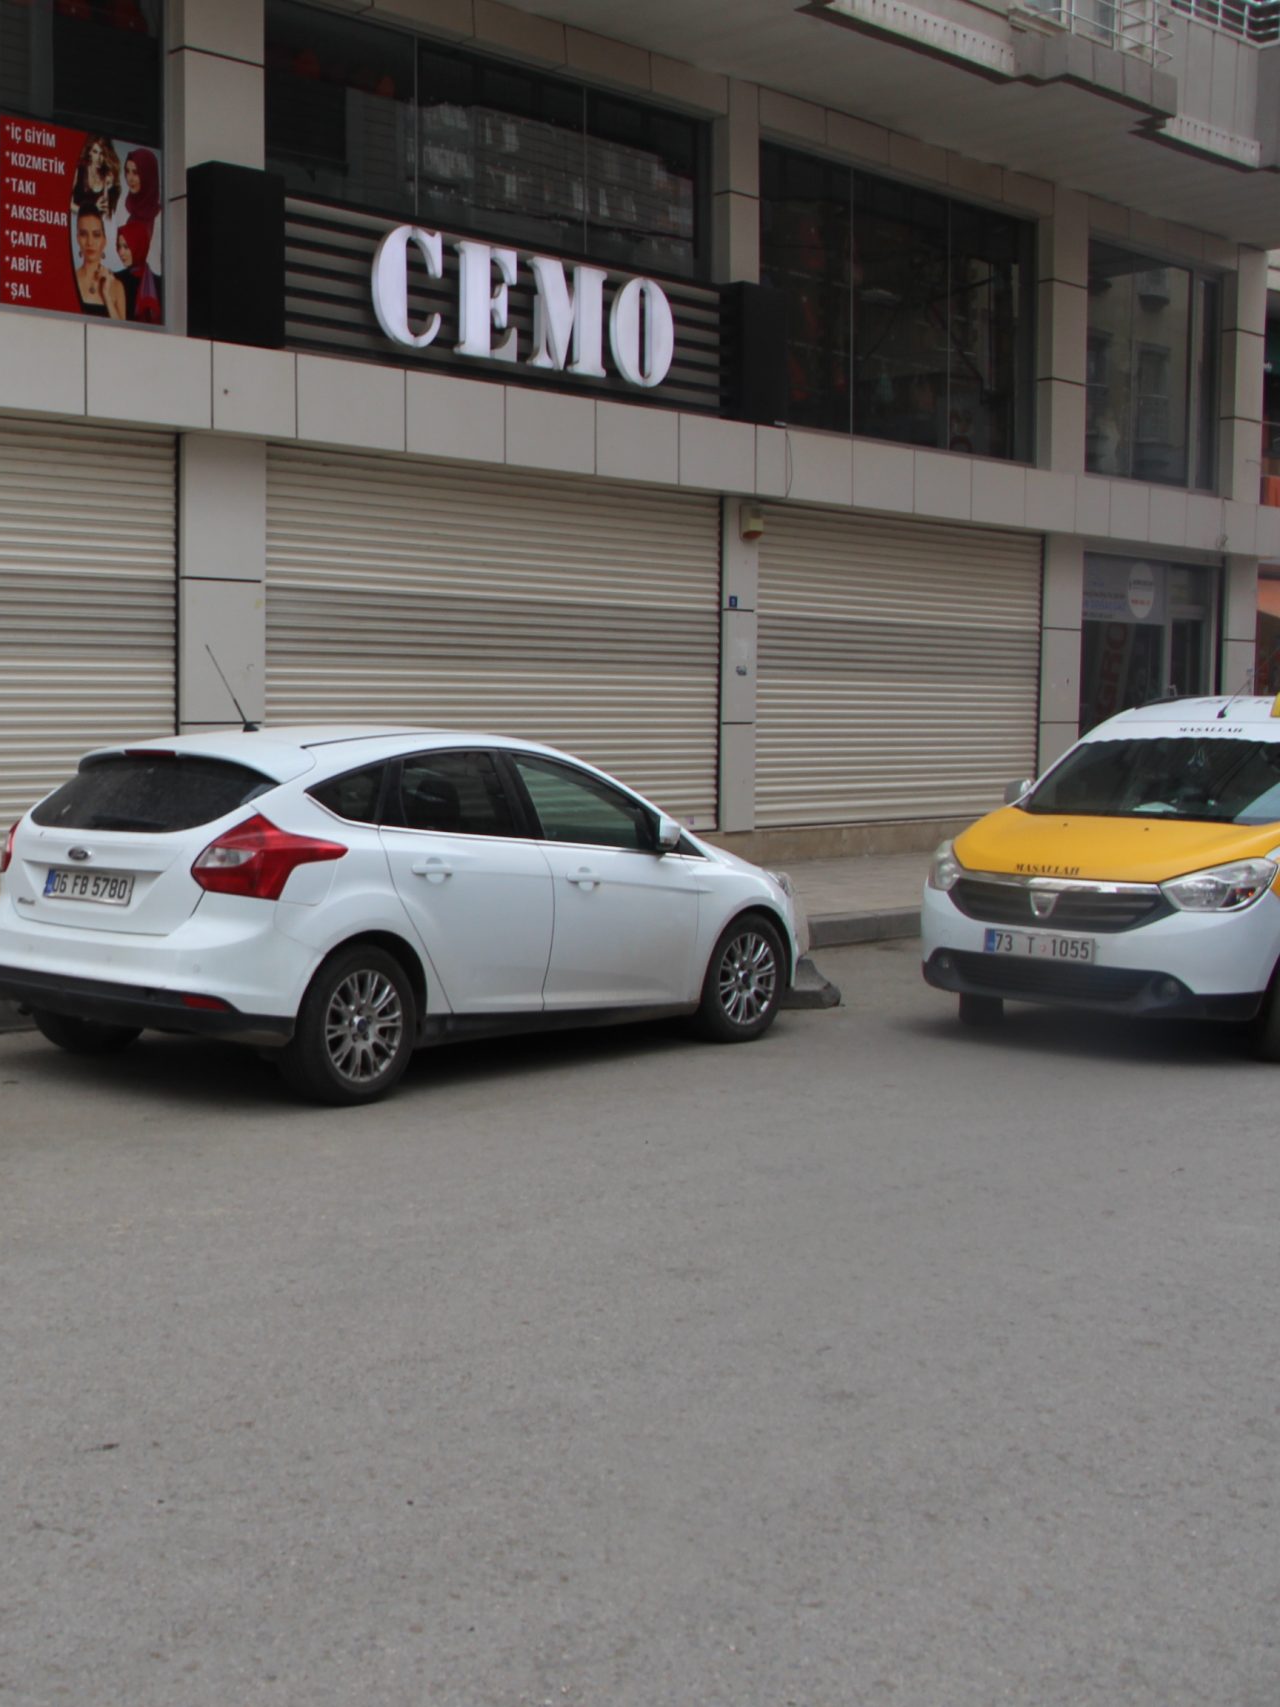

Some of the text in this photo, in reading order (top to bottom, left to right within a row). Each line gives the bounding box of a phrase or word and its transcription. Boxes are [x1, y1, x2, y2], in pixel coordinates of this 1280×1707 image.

[24, 126, 56, 148] GİYİM
[11, 152, 65, 175] KOZMETİK
[10, 177, 36, 196] TAKI
[11, 204, 67, 226] AKSESUAR
[10, 229, 47, 249] ÇANTA
[10, 255, 43, 275] ABİYE
[10, 281, 32, 301] ŞAL
[371, 225, 674, 388] CEMO
[52, 873, 128, 900] 06 FB 5780
[995, 932, 1090, 961] 73 T 1055
